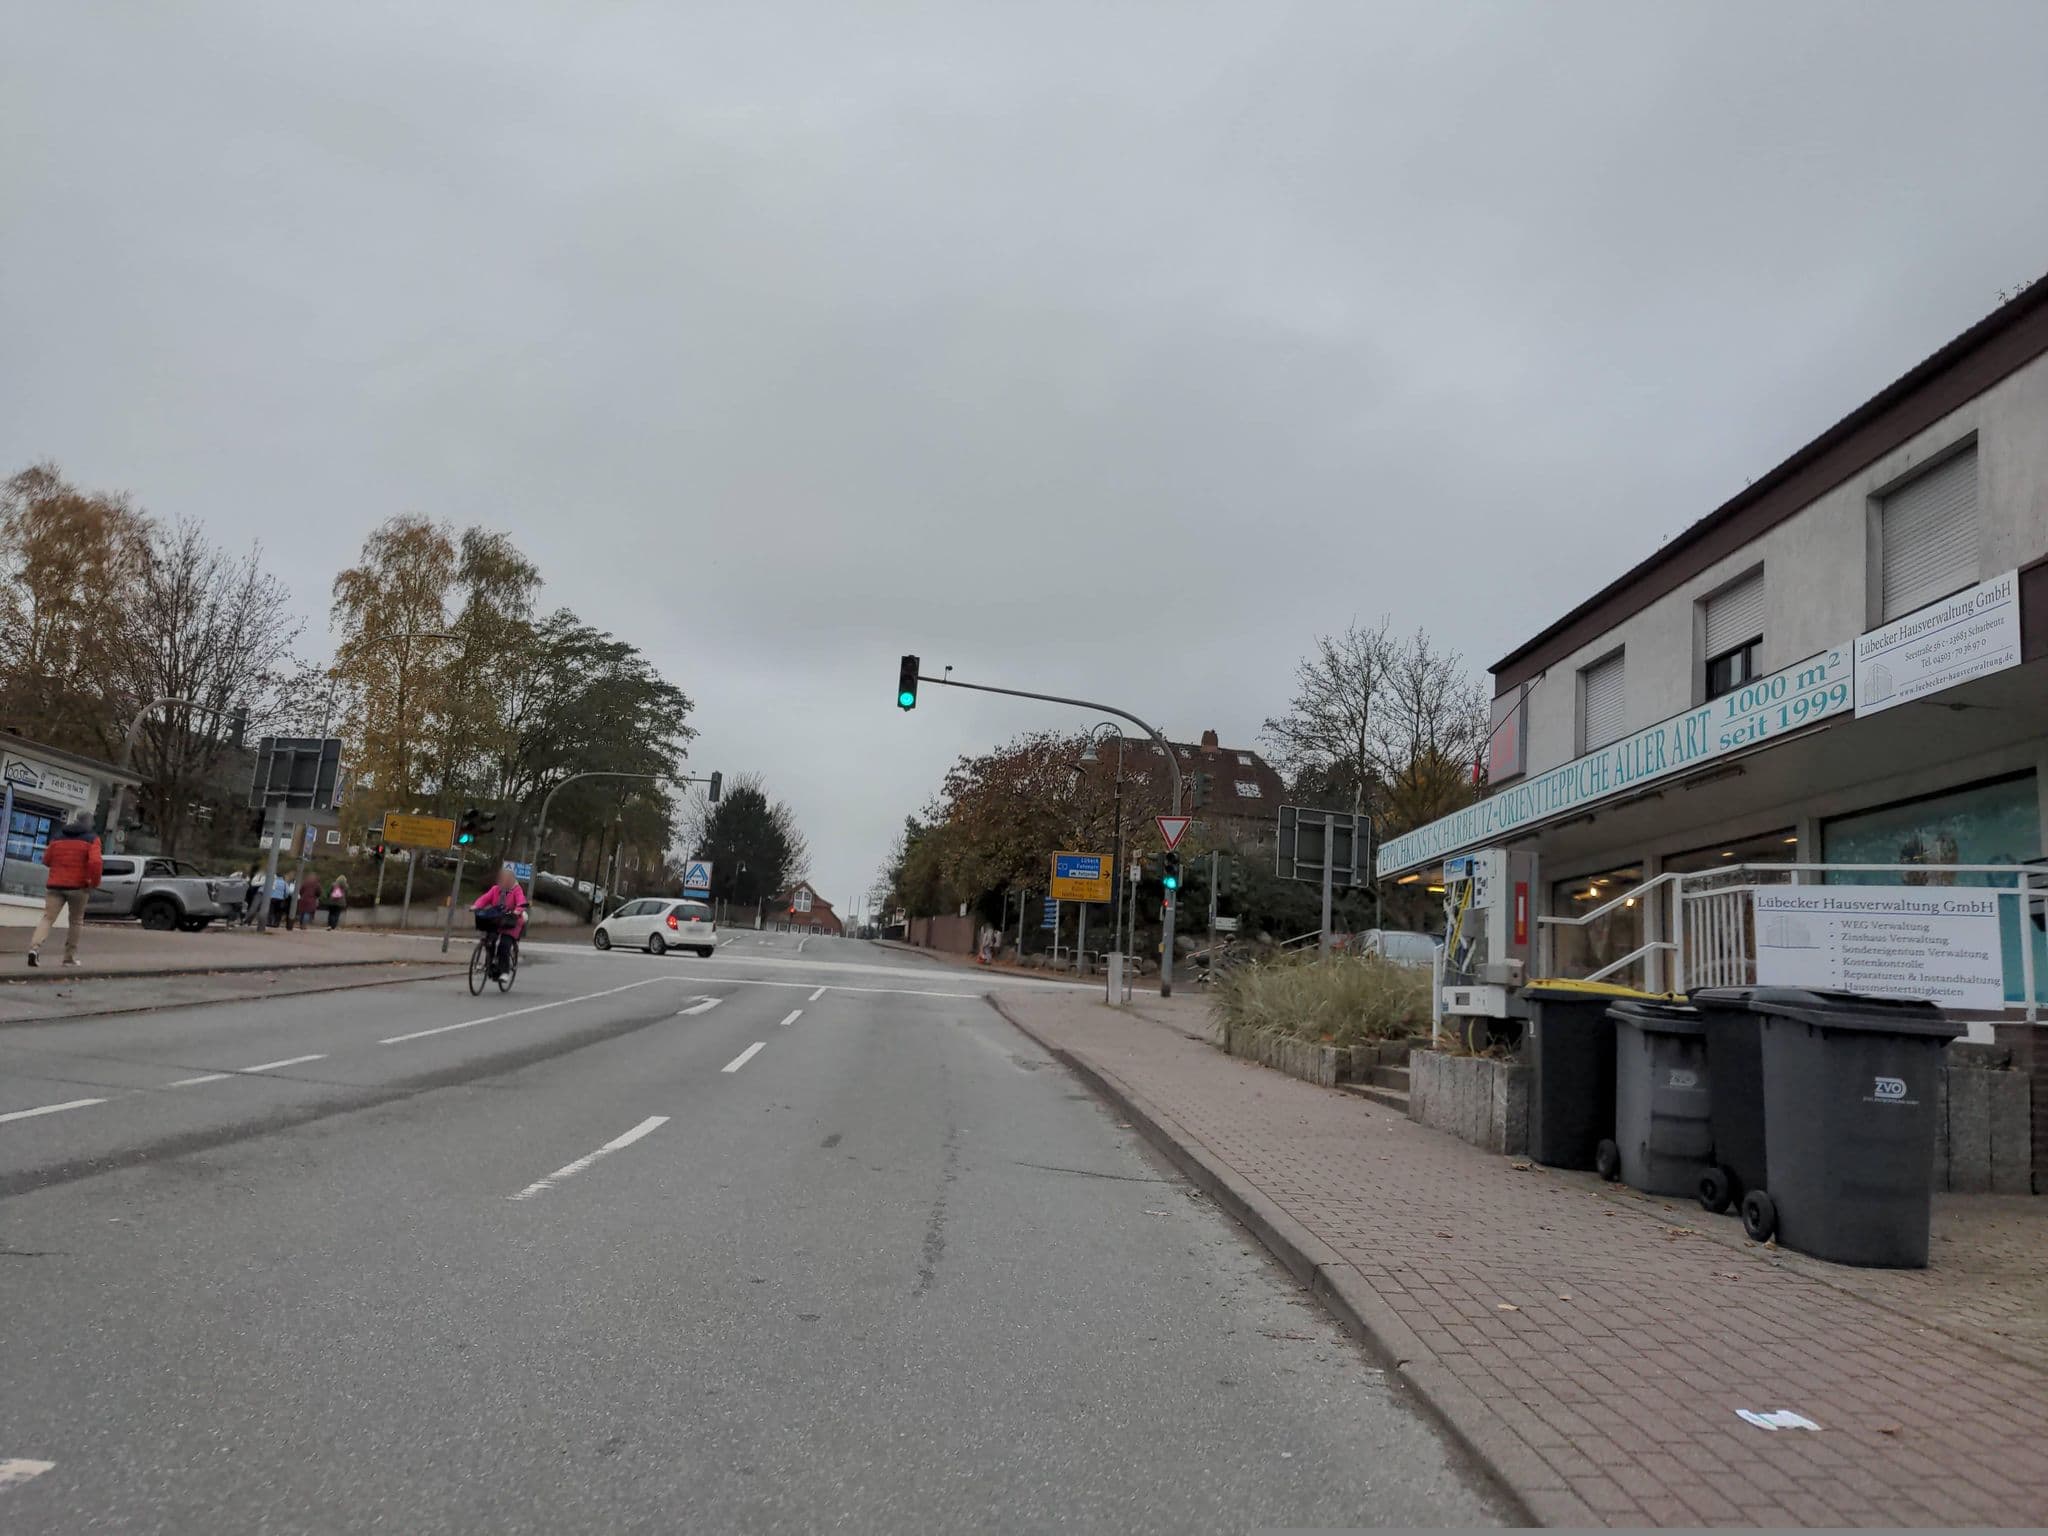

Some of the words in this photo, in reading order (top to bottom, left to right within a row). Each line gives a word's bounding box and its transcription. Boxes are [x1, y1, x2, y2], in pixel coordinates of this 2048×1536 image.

[1860, 630, 1898, 656] Lübecker
[1900, 601, 1974, 640] Hausverwaltung
[1976, 581, 2010, 608] GmbH
[1968, 617, 2004, 638] Scharbeutz
[1726, 676, 1786, 719] 1000
[1720, 712, 1768, 750] seit
[1777, 683, 1848, 730] 1999
[1614, 729, 1666, 786] ALLER
[1672, 710, 1712, 766] ART
[1758, 896, 1818, 910] Lübecker
[1824, 898, 1940, 914] Hausverwaltung
[1944, 900, 1994, 914] GmbH
[1841, 920, 1868, 930] WEG
[1872, 921, 1930, 932] Verwaltung
[1841, 932, 1888, 942] Zinshaus
[1890, 934, 1950, 946] Verwaltung
[1842, 945, 1925, 958] Sondereigentum
[1928, 948, 1990, 960] Verwaltung
[1842, 958, 1925, 968] Kostenkontrolle
[1844, 970, 1905, 982] Reparaturen
[1908, 972, 1916, 982] &
[1920, 973, 2002, 986] Instandhaltung
[1844, 982, 1964, 997] Hausmeistertätigkeiten
